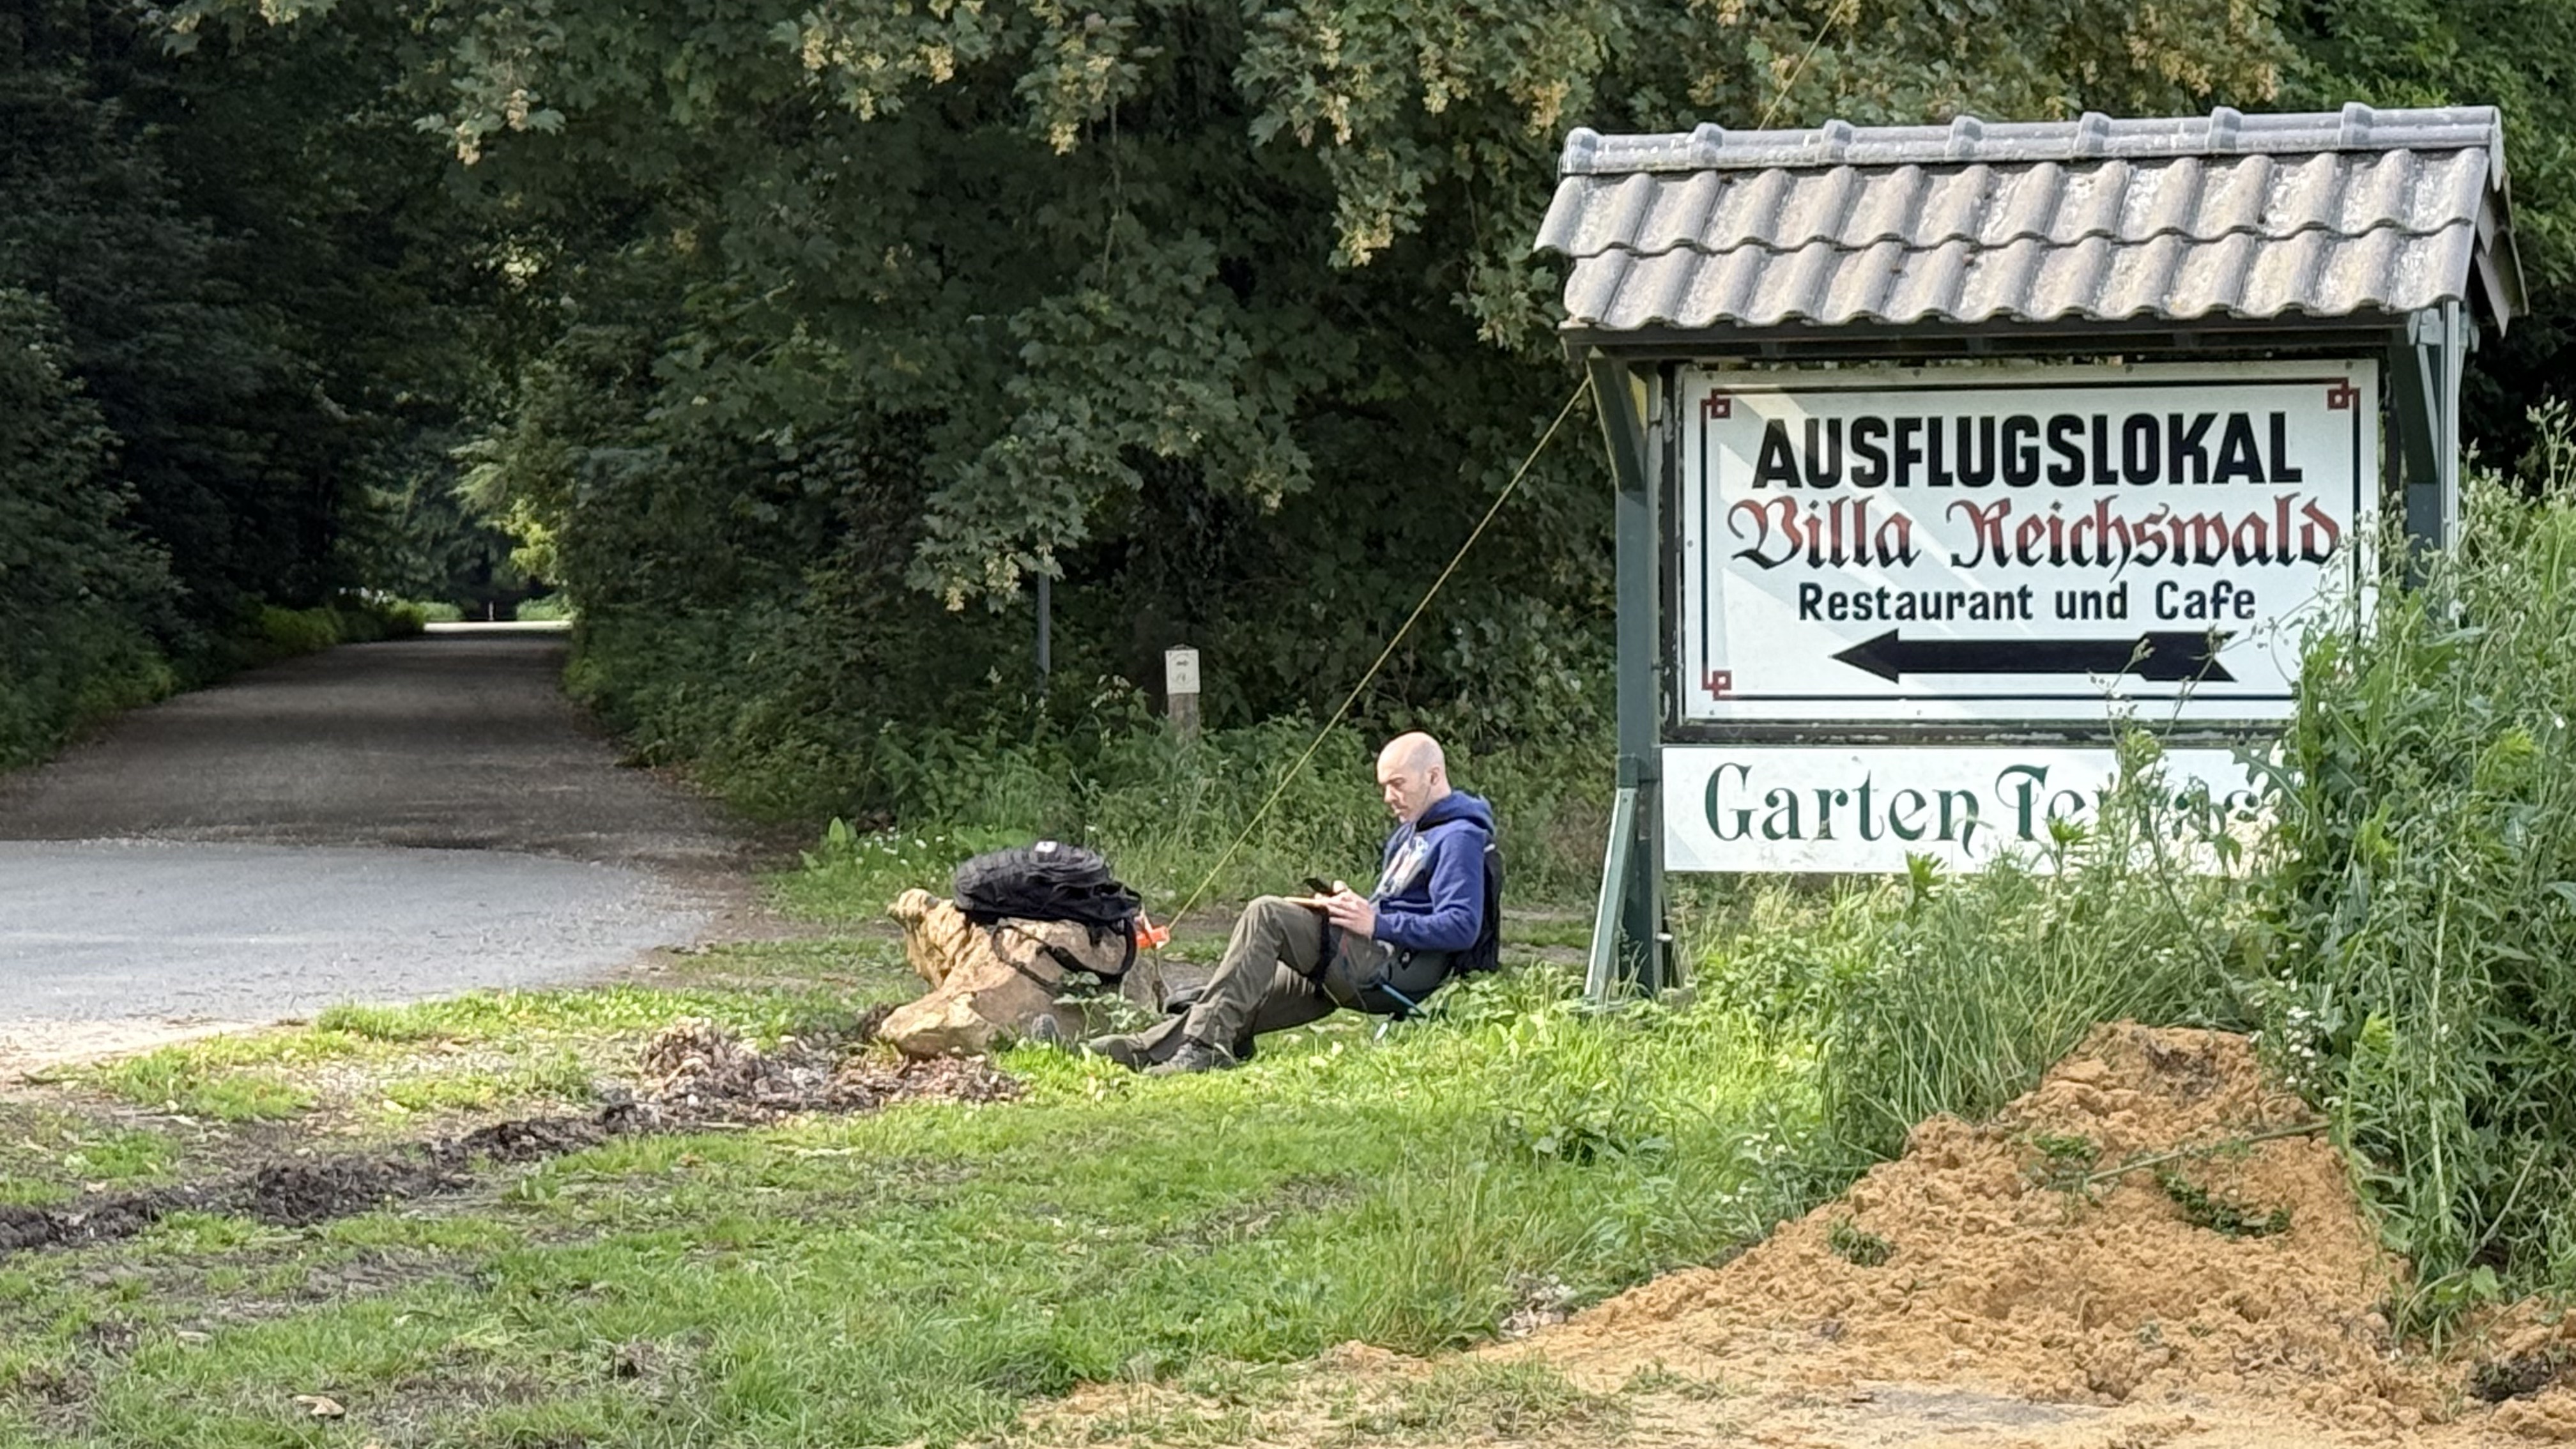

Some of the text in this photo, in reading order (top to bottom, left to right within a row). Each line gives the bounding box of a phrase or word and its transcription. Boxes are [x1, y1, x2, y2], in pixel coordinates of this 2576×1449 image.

[1752, 411, 2303, 489] AUSFLUGSLOKAL
[1727, 492, 2340, 583] Villa Reichswald
[1799, 580, 2256, 622] Restaurant und Cafe
[1705, 762, 1979, 858] Garten
